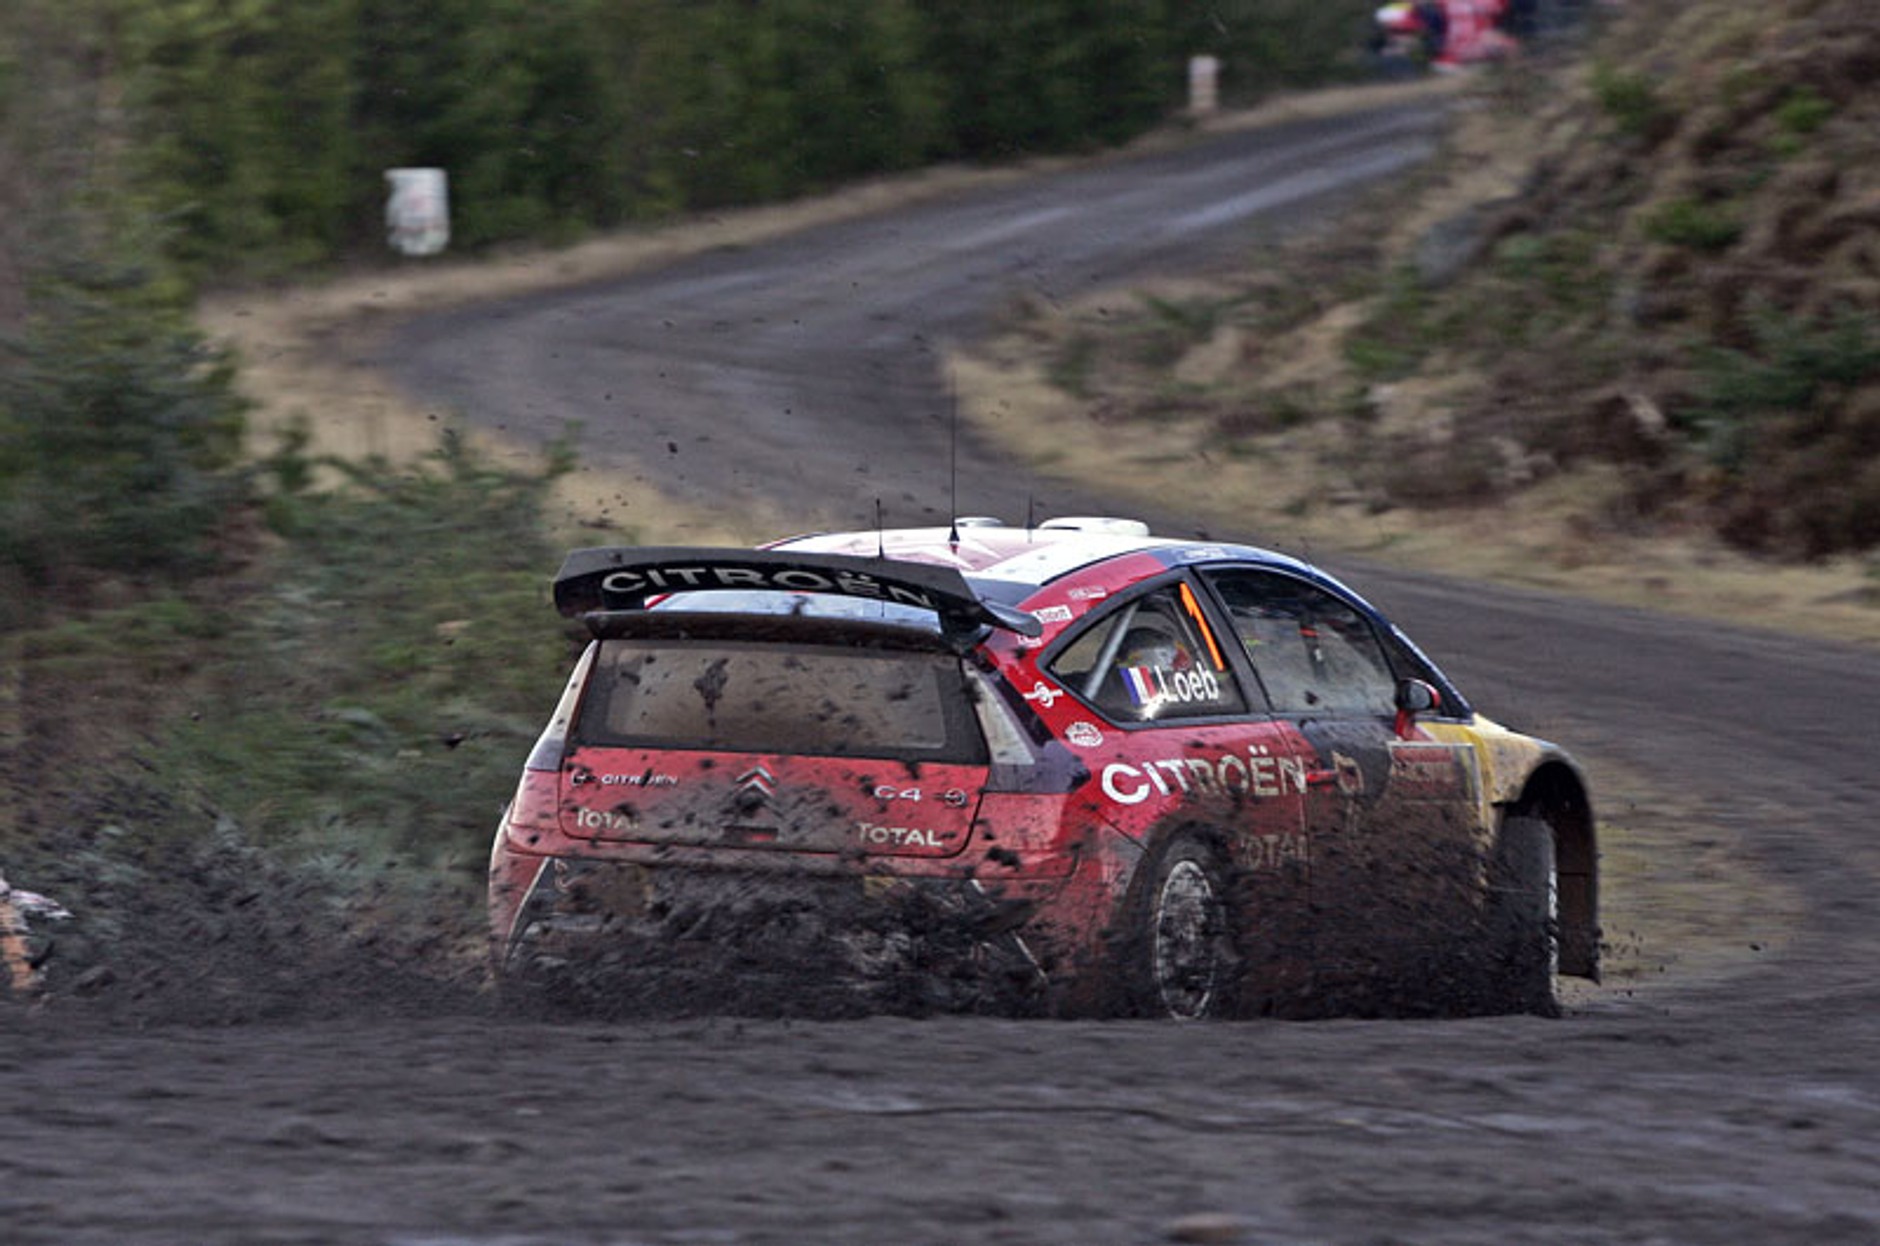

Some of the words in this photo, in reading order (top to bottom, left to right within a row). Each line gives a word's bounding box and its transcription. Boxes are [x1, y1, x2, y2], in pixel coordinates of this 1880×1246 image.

[601, 567, 935, 608] CITROËN
[1153, 661, 1219, 703] Loeb
[1101, 745, 1308, 805] CITROËN
[576, 806, 640, 829] TOTA
[857, 822, 944, 847] TOTAL
